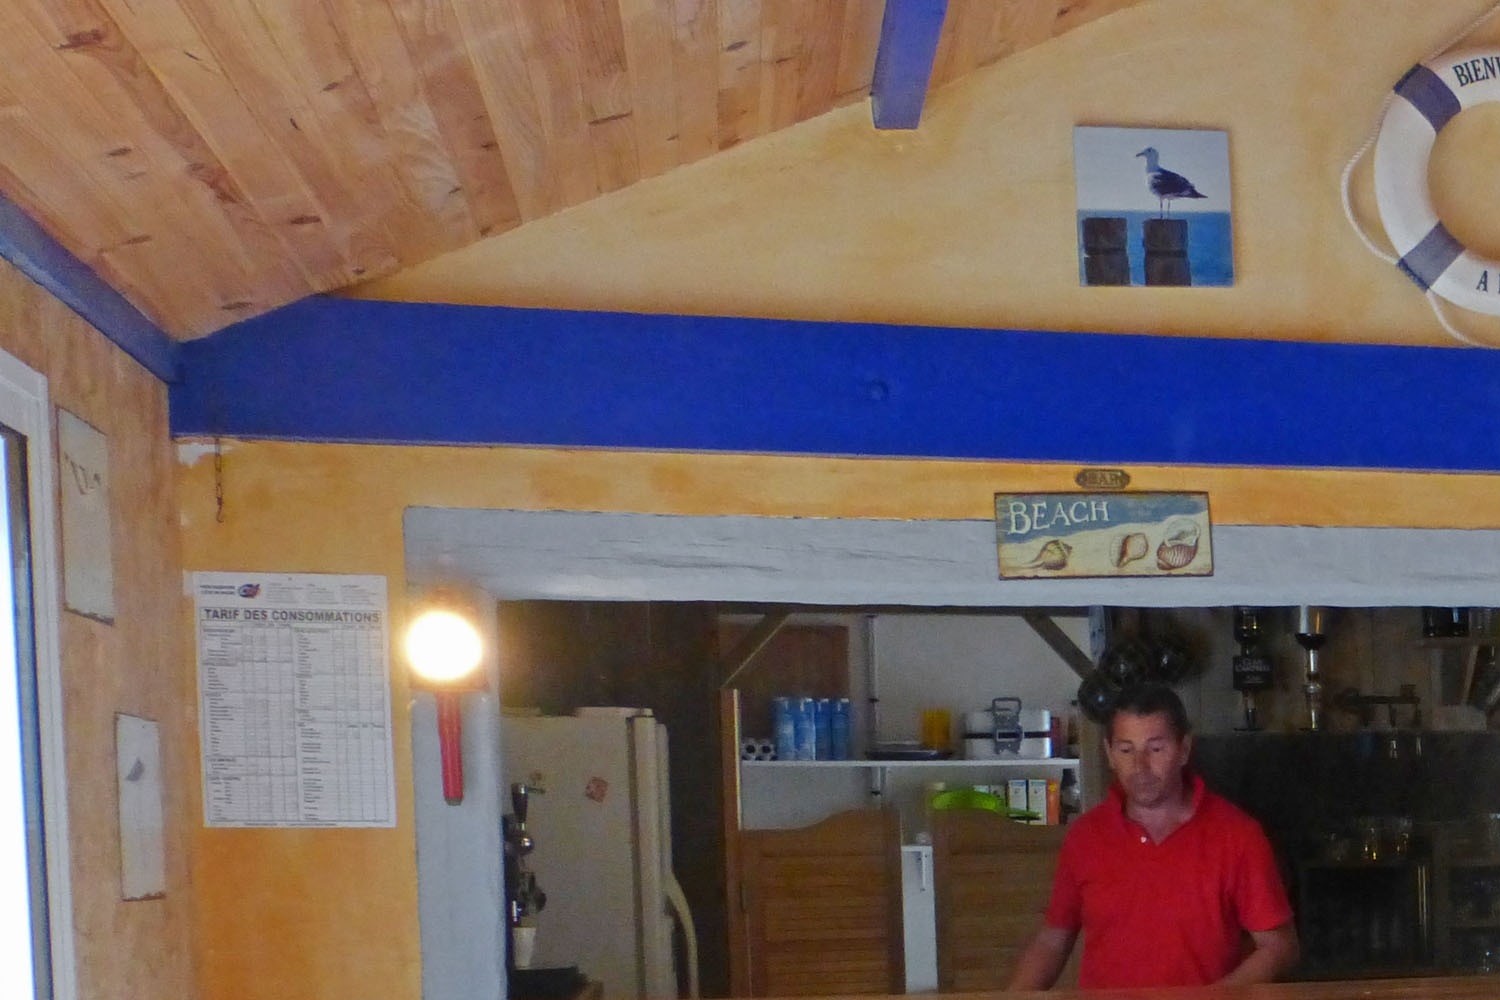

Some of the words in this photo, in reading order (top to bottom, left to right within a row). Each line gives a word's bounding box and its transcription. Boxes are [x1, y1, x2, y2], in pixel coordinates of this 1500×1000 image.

[1475, 270, 1488, 292] A
[1007, 501, 1109, 535] BEACH
[204, 608, 240, 620] TARIF
[244, 609, 268, 621] DES
[272, 610, 380, 623] CONSOMMATIONS
